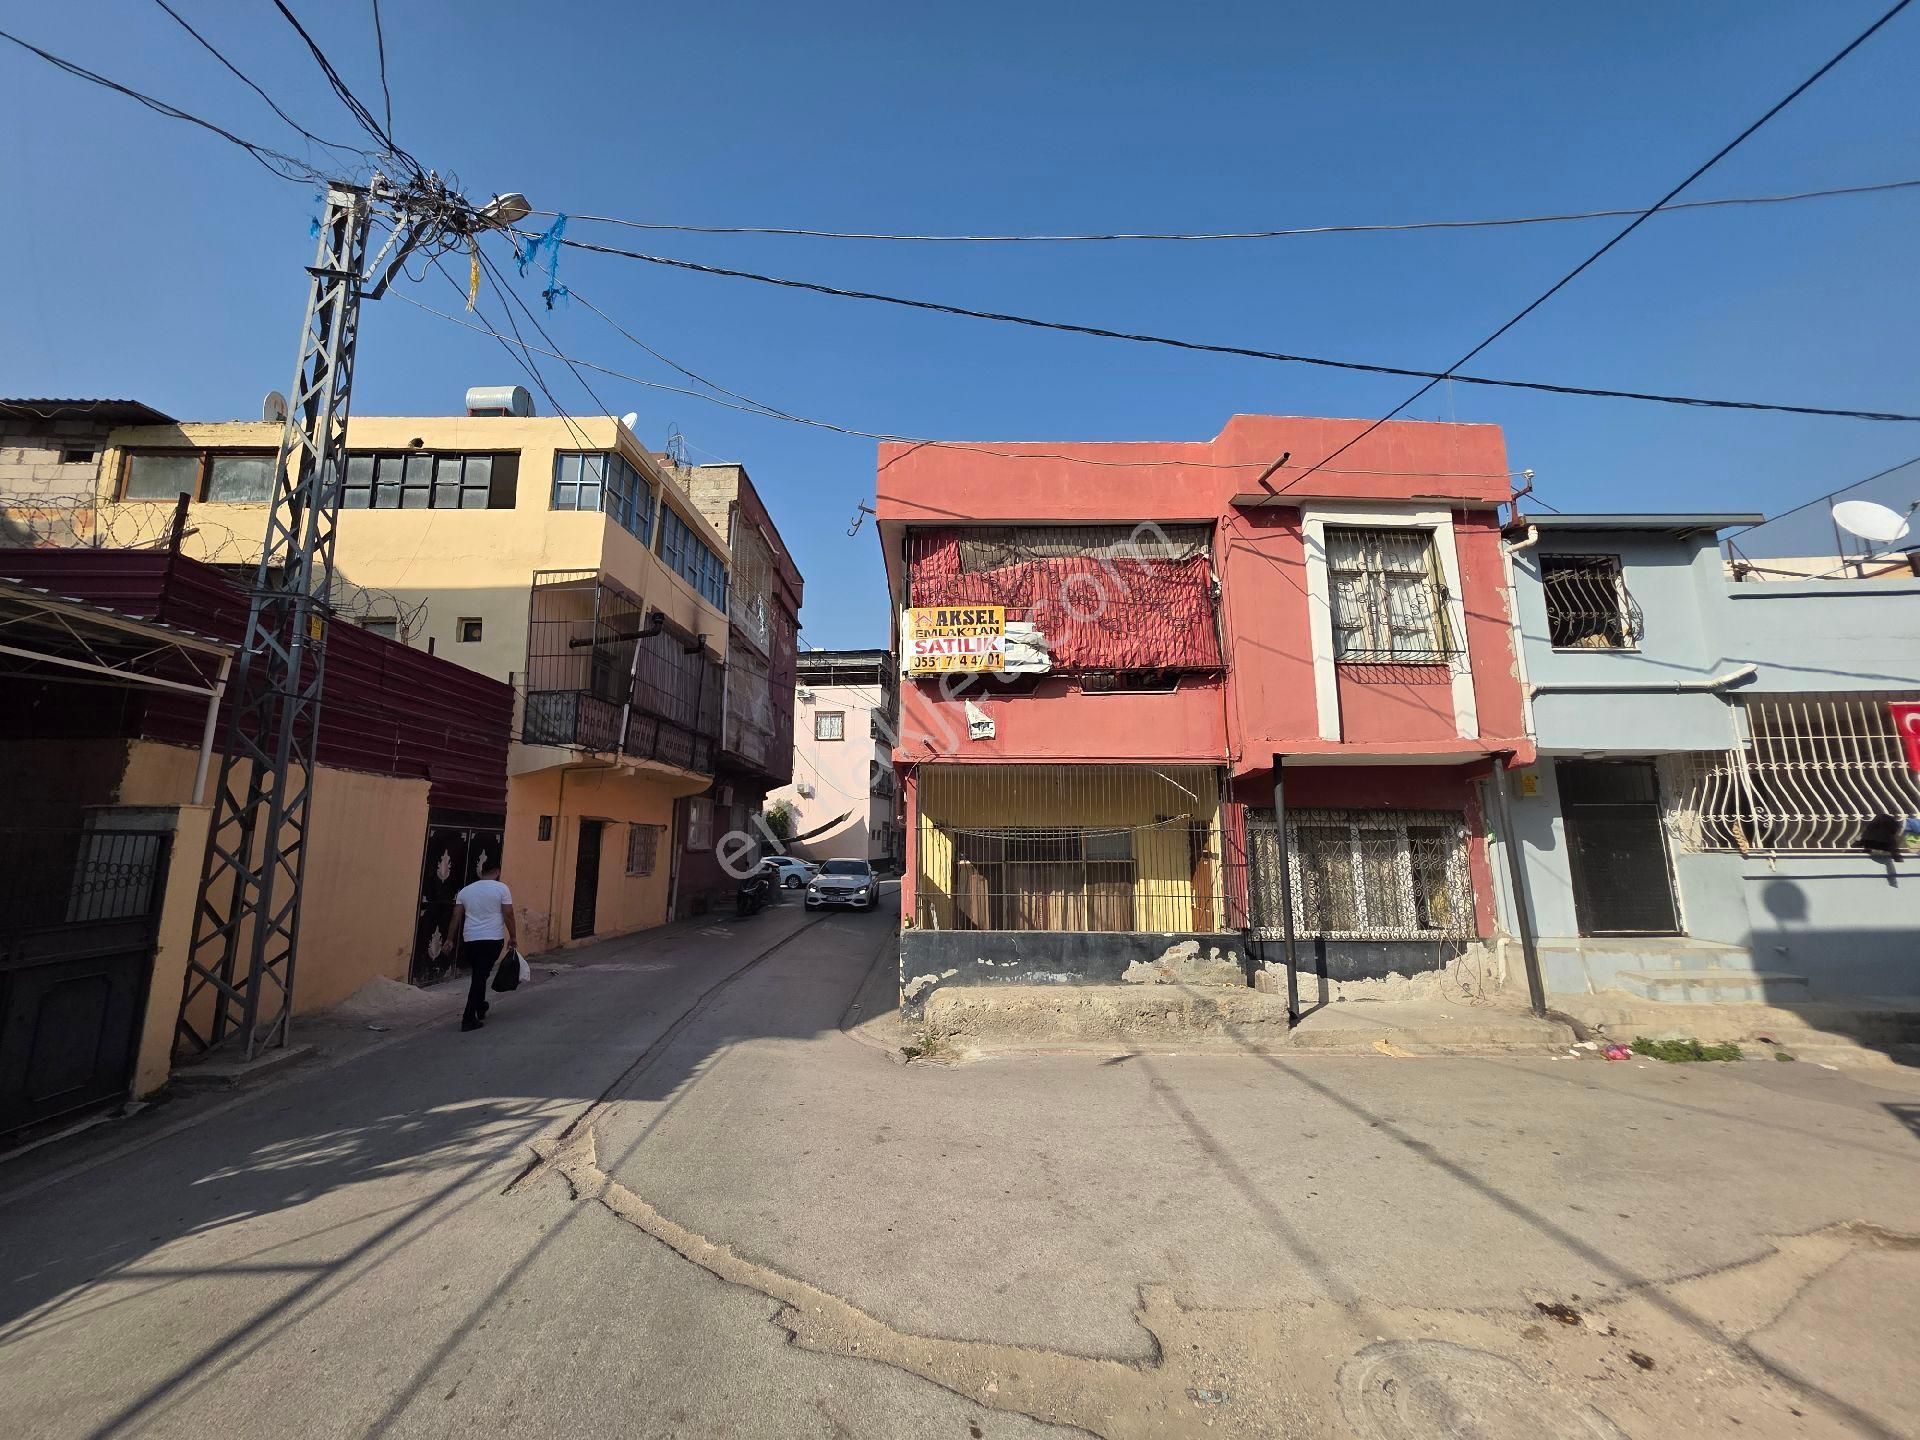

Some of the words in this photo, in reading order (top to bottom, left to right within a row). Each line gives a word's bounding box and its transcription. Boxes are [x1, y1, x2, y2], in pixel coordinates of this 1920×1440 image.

[936, 609, 1000, 627] AKSEL
[915, 626, 1000, 638] EMLAK'TAN
[914, 636, 999, 655] SATILIK
[946, 655, 967, 667] 74
[988, 653, 1000, 666] 01
